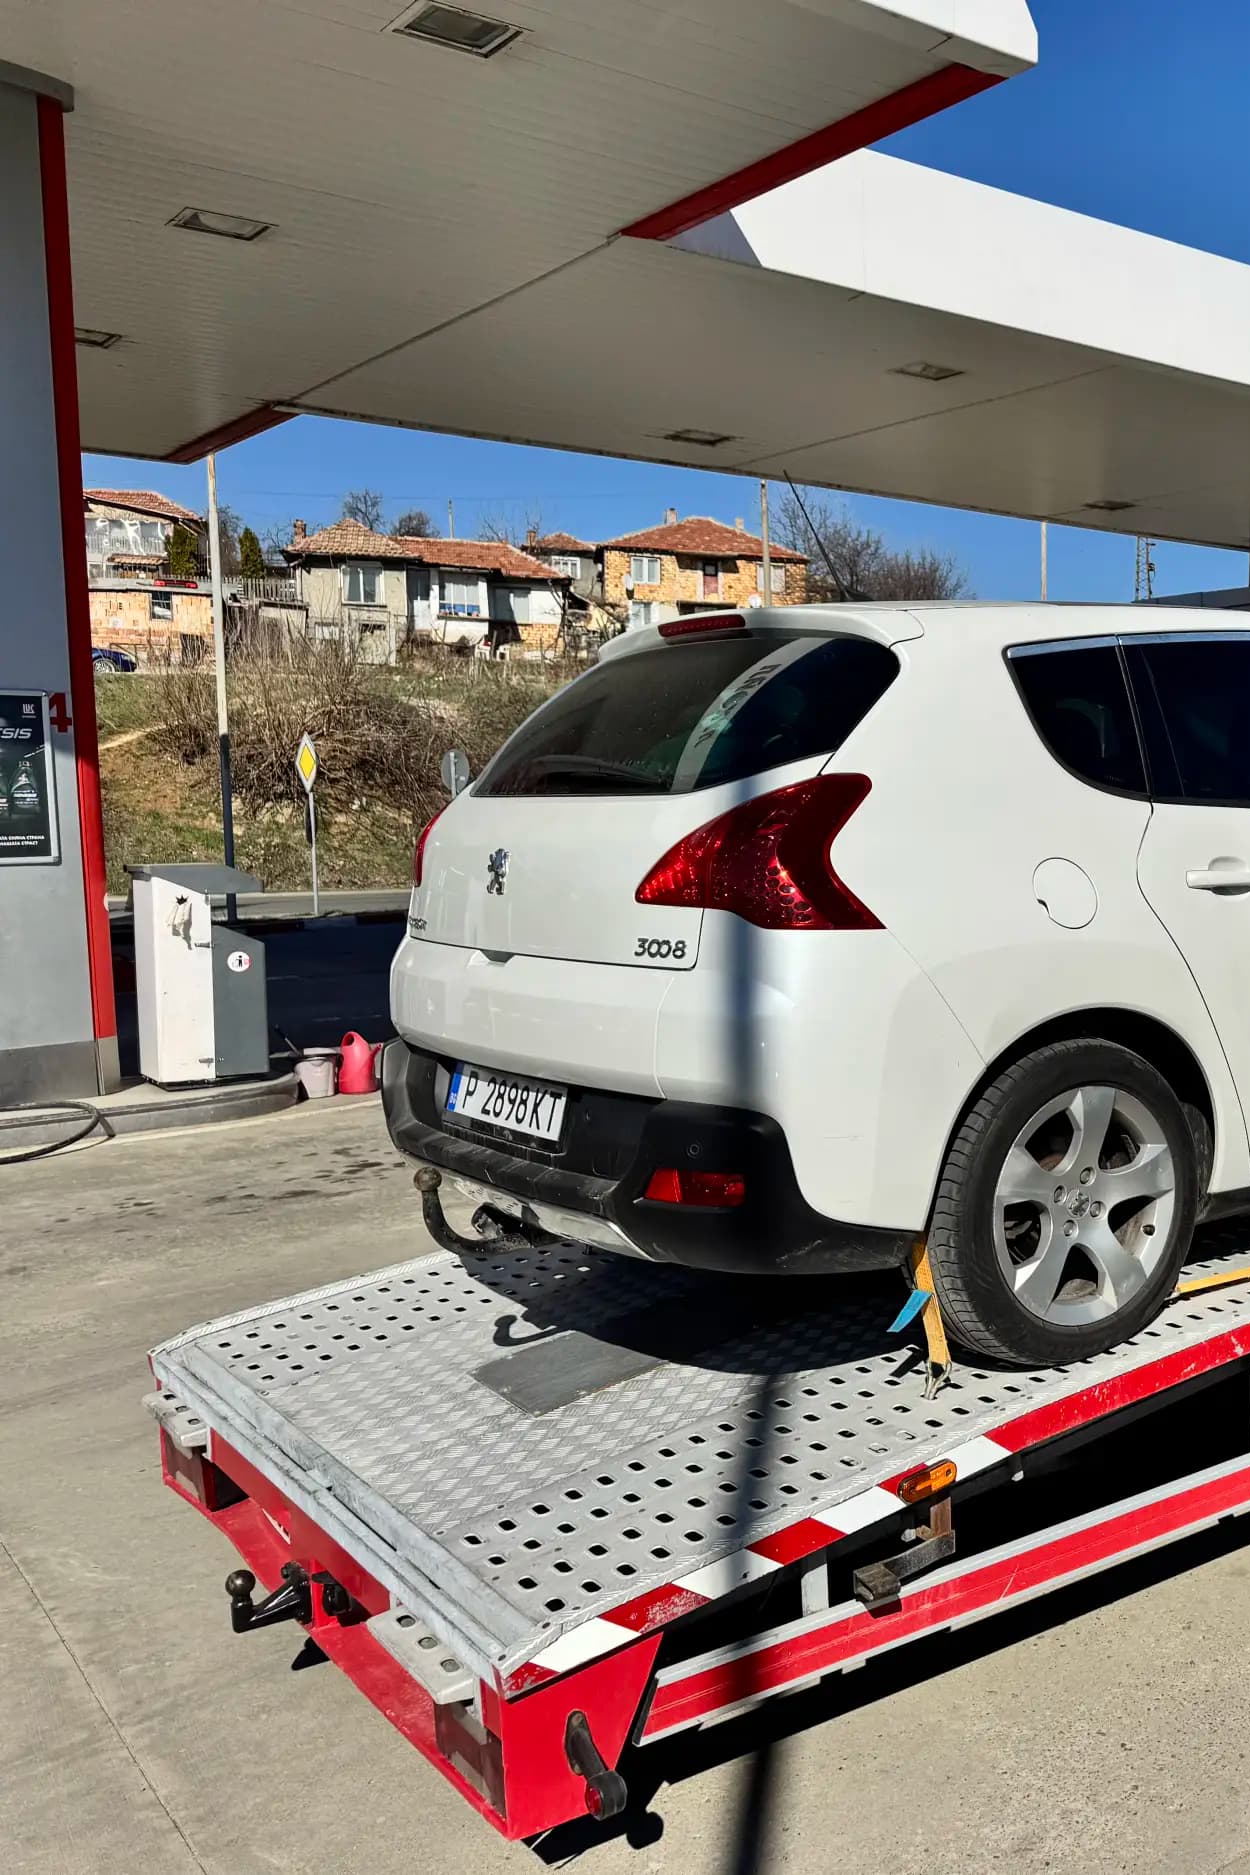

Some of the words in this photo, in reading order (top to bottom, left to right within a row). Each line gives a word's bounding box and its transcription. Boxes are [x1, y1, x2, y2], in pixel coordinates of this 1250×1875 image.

[49, 692, 72, 733] 4
[0, 727, 33, 739] SIS
[634, 937, 687, 960] 3008
[462, 1070, 479, 1109] P
